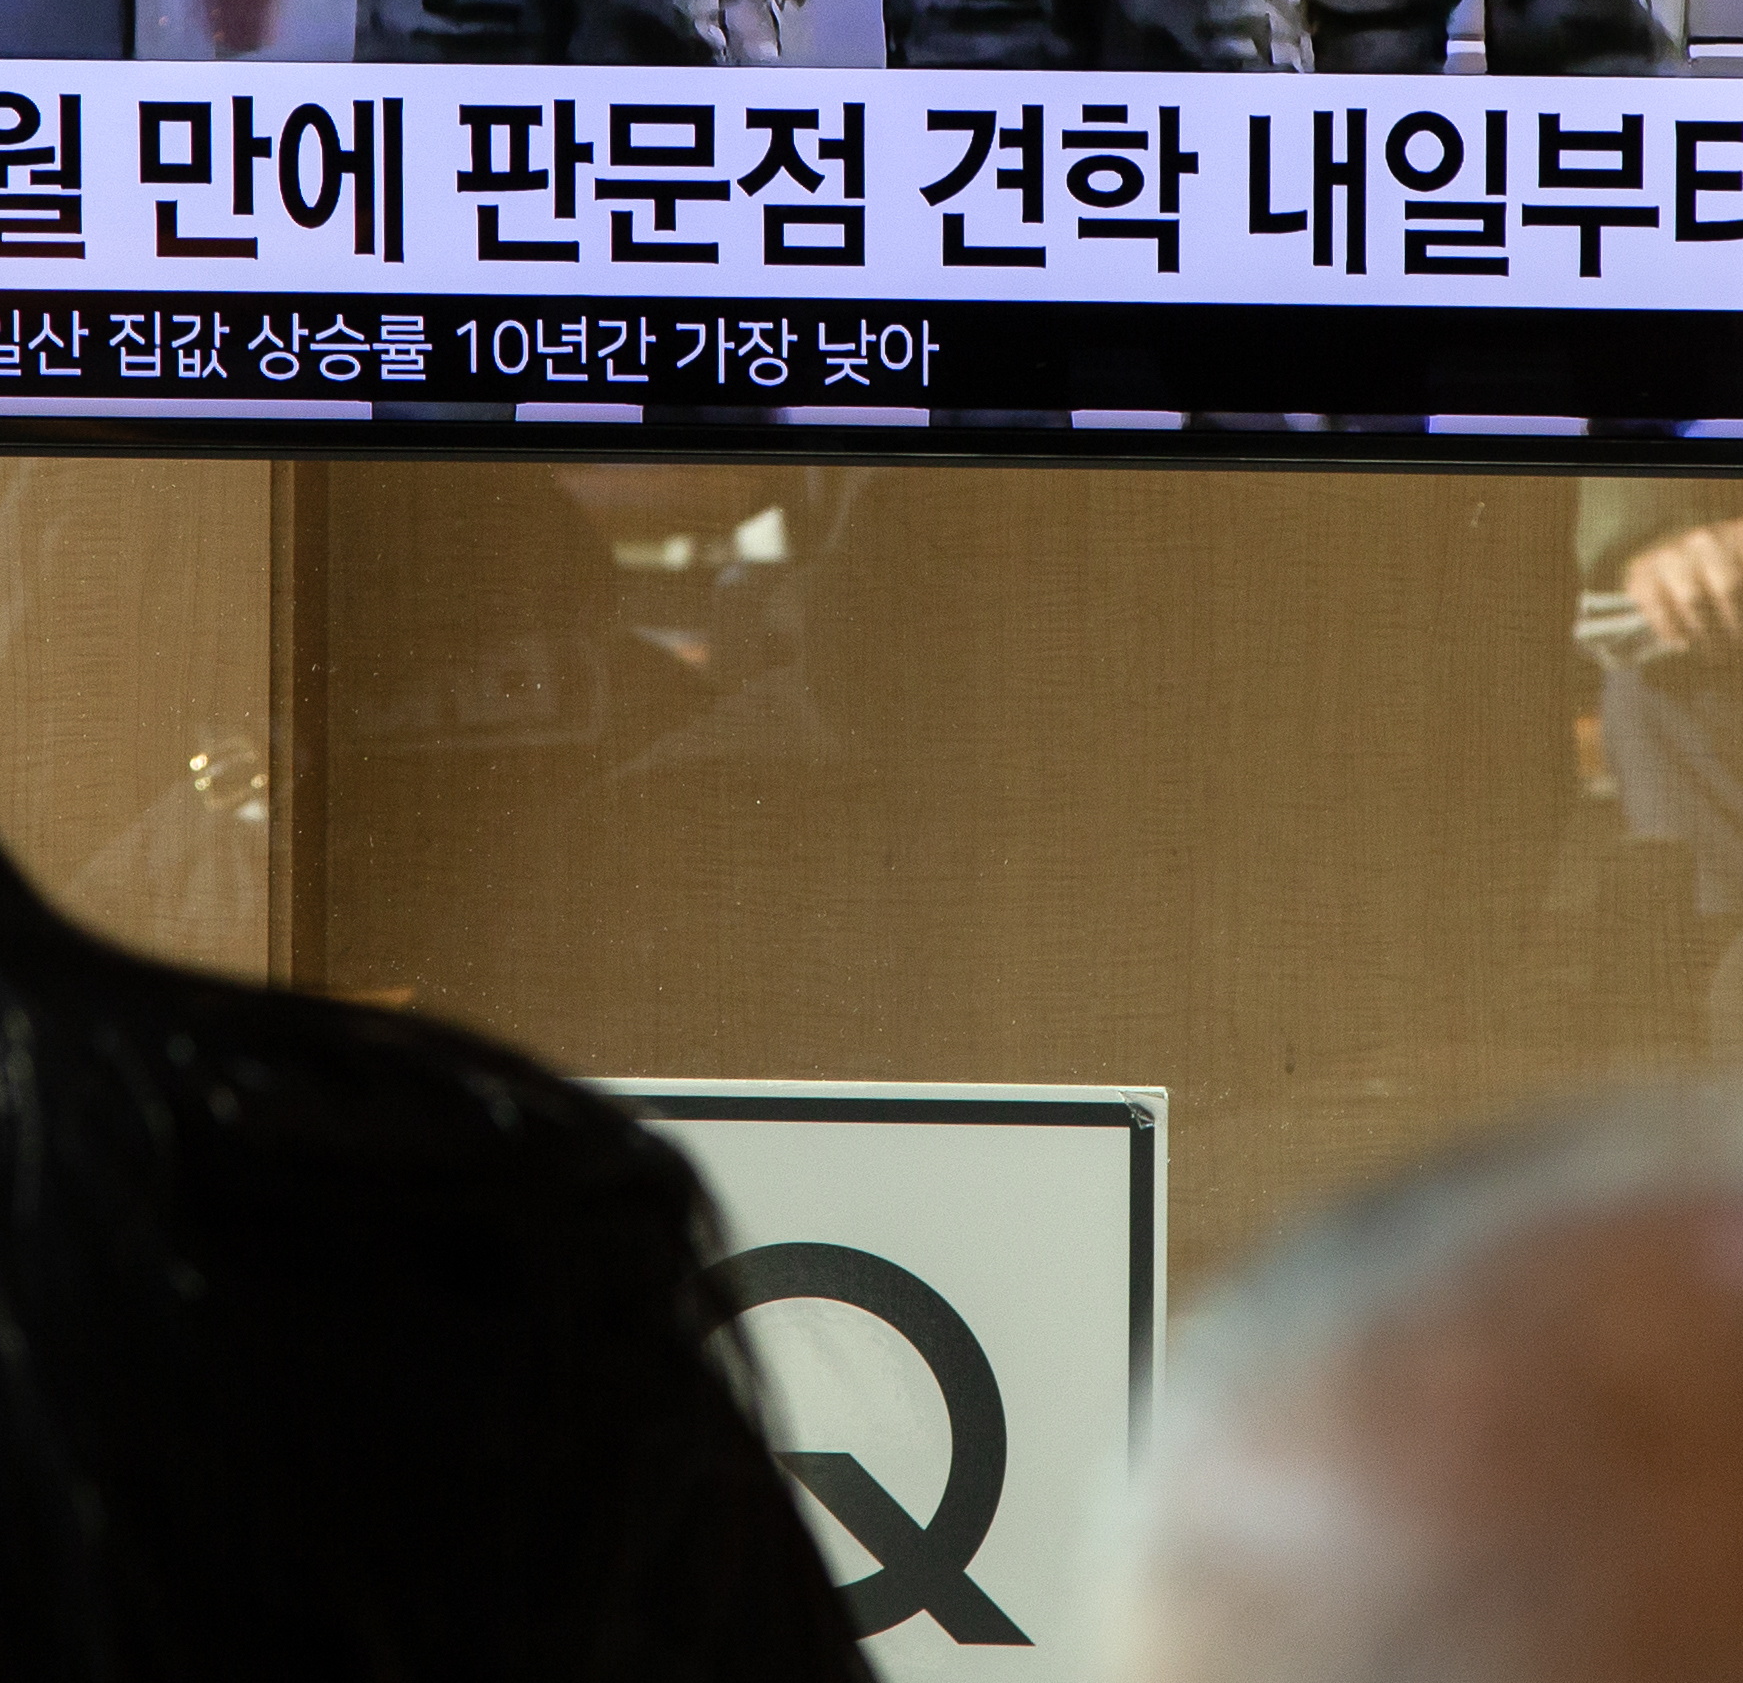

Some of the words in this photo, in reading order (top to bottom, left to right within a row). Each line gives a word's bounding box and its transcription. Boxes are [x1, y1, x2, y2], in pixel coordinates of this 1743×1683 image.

[138, 95, 405, 263] 만에
[456, 99, 866, 267] 판문점
[919, 104, 1199, 274] 견학
[109, 310, 230, 379] 집값
[247, 312, 433, 382] 상승률
[455, 316, 657, 383] 10년간
[675, 317, 798, 387] 가장
[817, 319, 940, 387] 낮아
[676, 1240, 1036, 1646] Q
